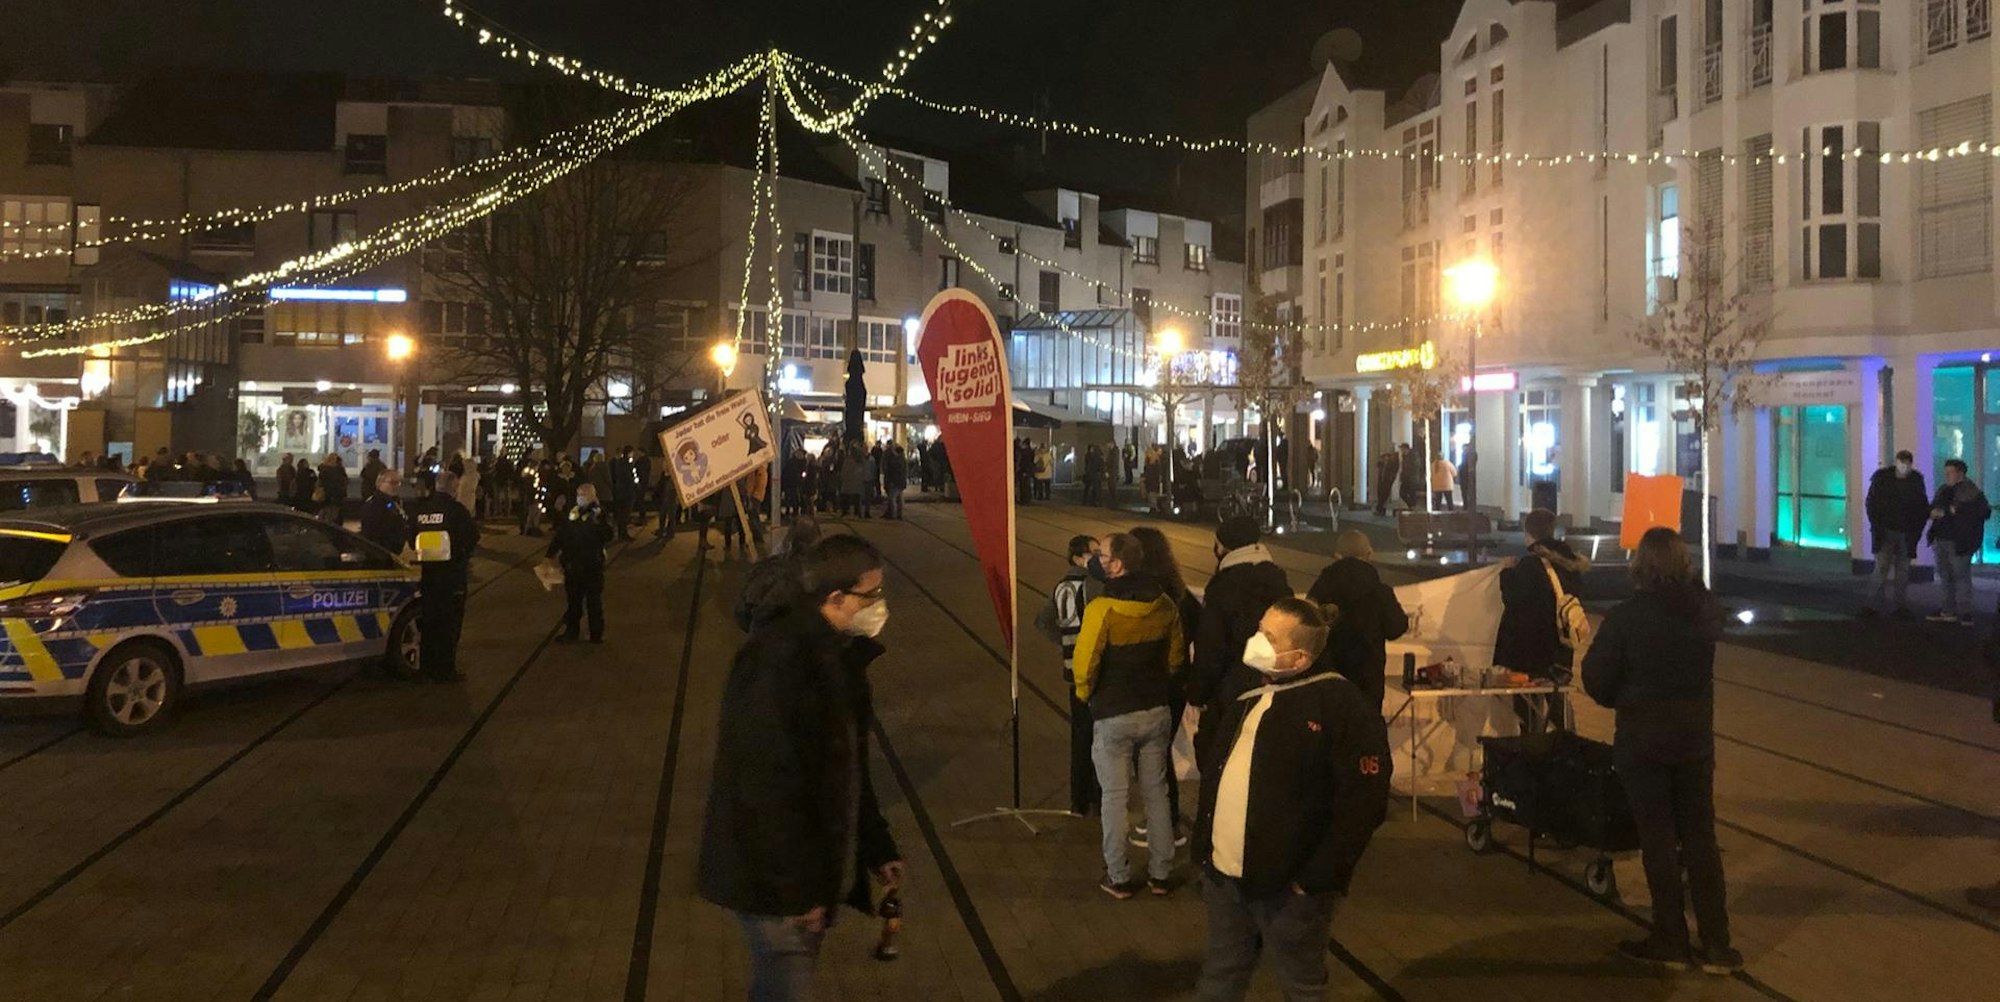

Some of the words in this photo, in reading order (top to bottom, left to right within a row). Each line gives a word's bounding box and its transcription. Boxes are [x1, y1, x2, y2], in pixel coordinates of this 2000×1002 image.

[955, 345, 989, 367] links
[940, 355, 995, 391] jugend
[711, 433, 730, 448] oder
[685, 492, 695, 501] Du
[417, 512, 444, 524] POLIZEI
[312, 590, 369, 608] POLIZEI
